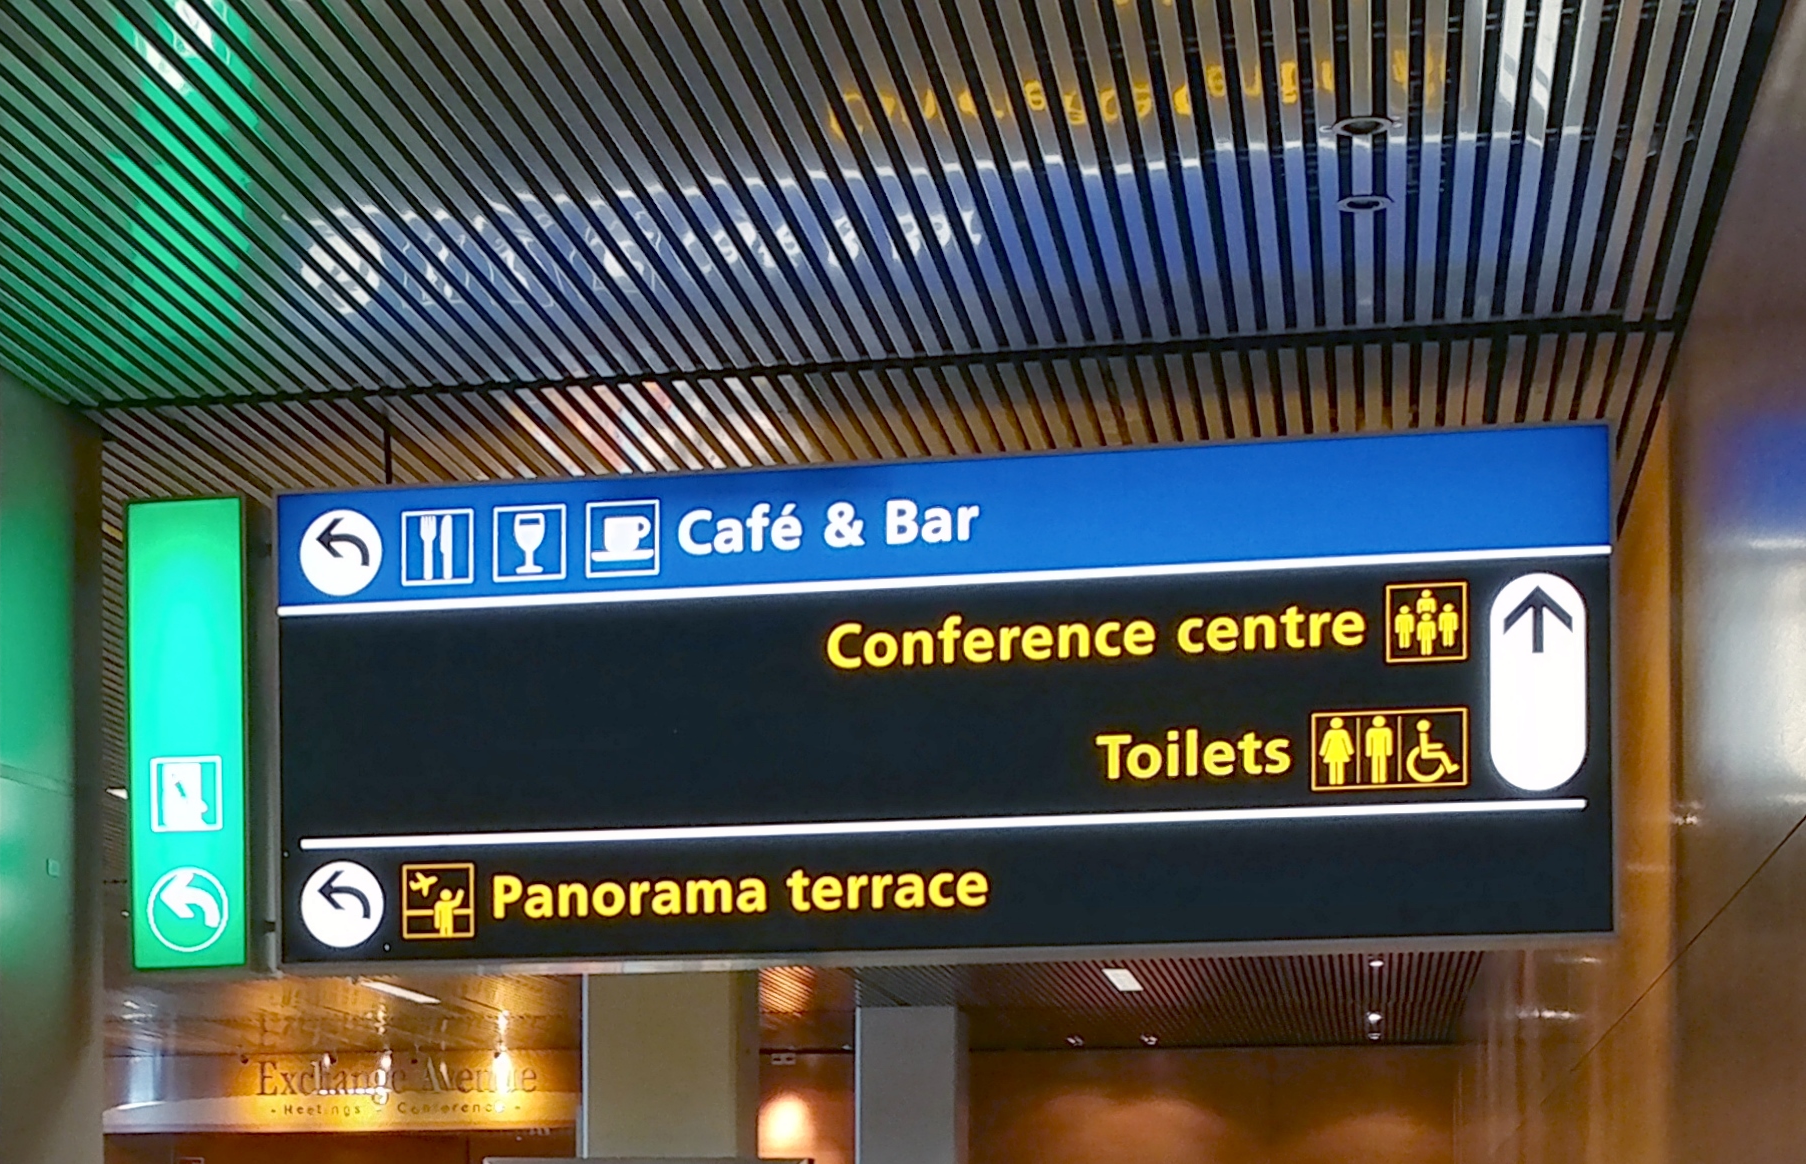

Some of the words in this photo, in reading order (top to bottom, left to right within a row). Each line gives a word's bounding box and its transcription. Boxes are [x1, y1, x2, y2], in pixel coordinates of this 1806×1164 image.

[678, 503, 802, 555] Café
[824, 502, 865, 548] &
[886, 499, 979, 545] Bar
[826, 615, 1156, 669] Conference
[1177, 605, 1365, 654] centre
[1095, 728, 1291, 780] Toilets
[493, 875, 767, 919] Panorama
[785, 869, 989, 912] terrace
